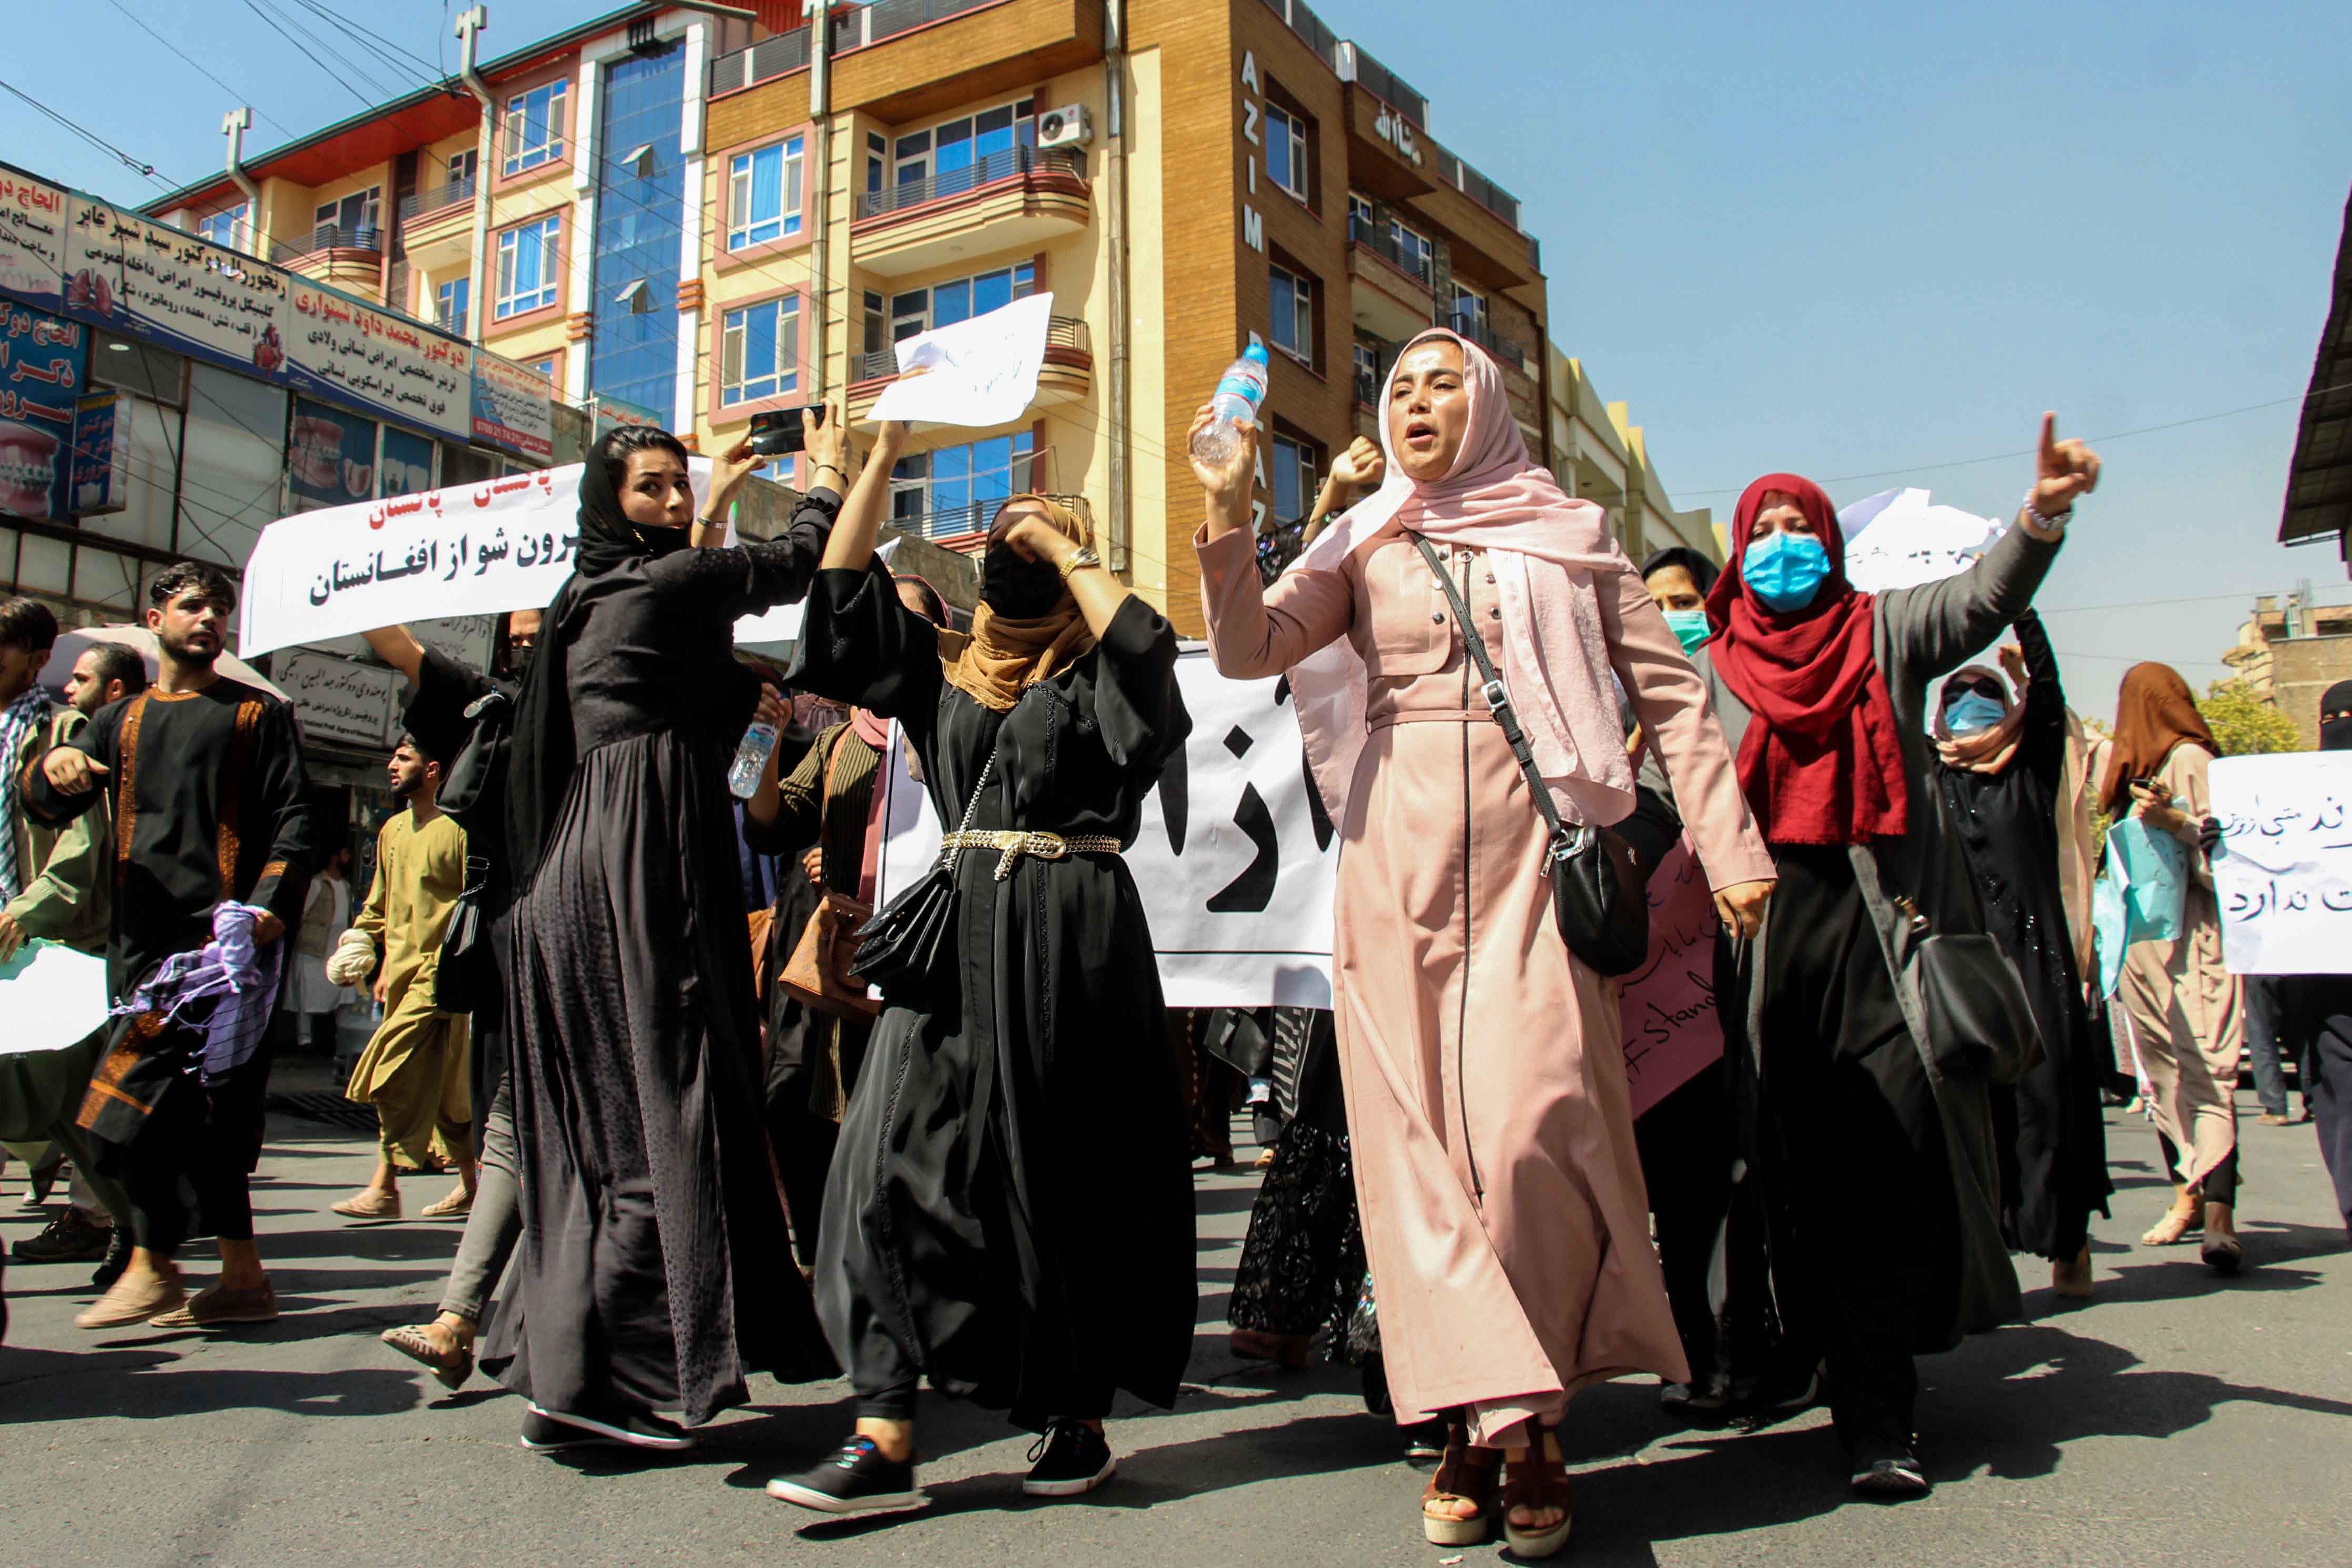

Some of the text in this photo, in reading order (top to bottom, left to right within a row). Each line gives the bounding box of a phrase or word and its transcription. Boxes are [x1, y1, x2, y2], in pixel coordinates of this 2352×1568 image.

[1241, 50, 1263, 252] AZIM
[18, 185, 60, 214] الحاج
[33, 316, 79, 349] الحاج
[386, 326, 419, 349] محمد
[309, 538, 438, 607] افغانستان
[442, 534, 468, 582] از
[474, 527, 508, 577] شو
[2229, 879, 2308, 923] ندارد
